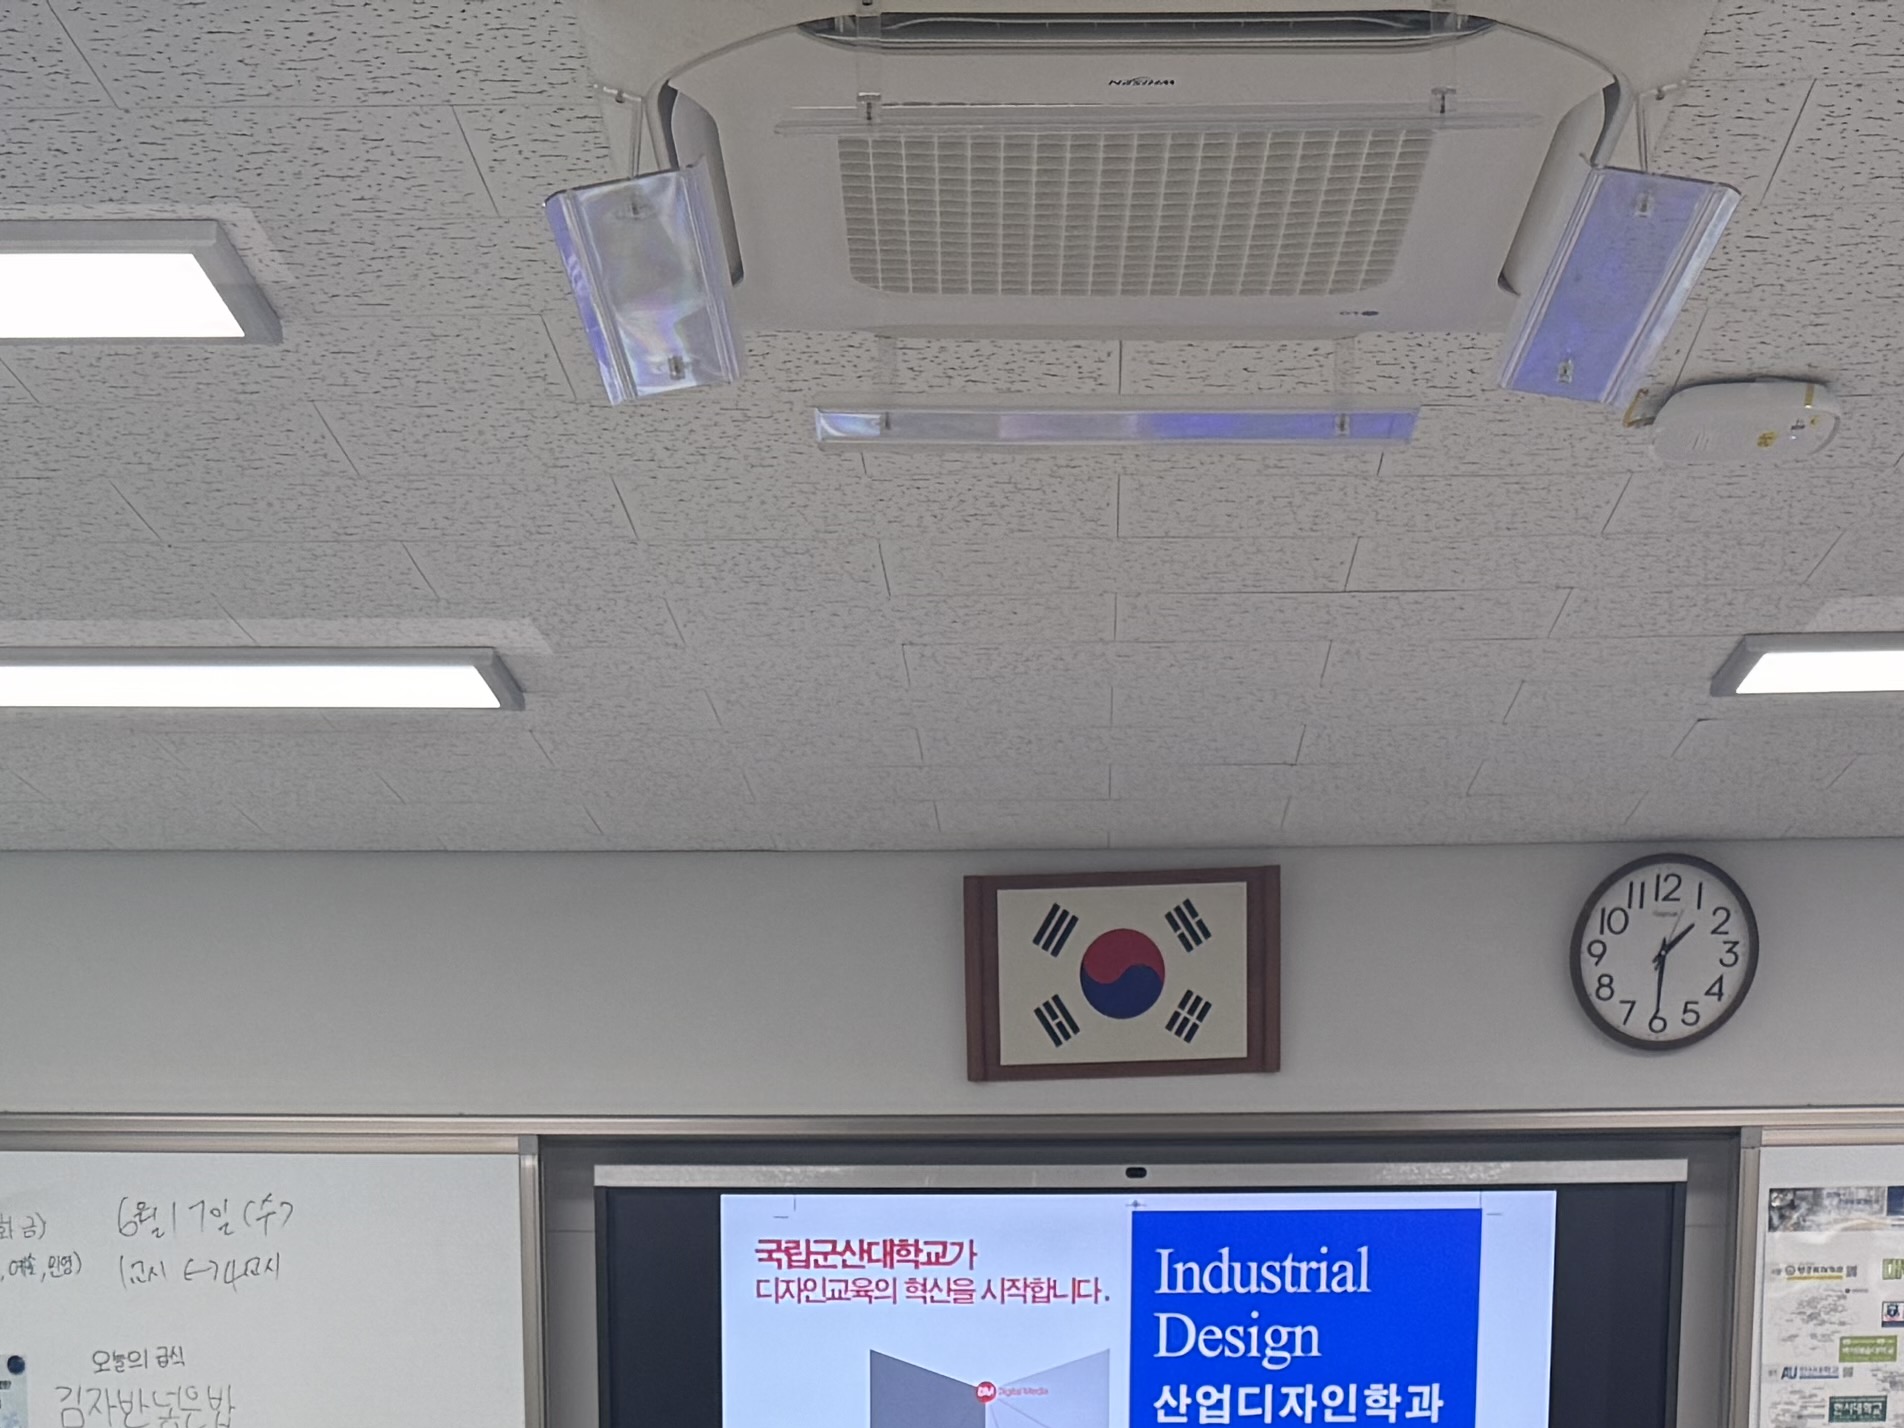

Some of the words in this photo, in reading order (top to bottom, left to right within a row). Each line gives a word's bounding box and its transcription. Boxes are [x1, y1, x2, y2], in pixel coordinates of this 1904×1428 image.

[1628, 881, 1645, 909] 11
[1655, 873, 1682, 902] 12
[1697, 881, 1703, 910] 1
[1600, 907, 1629, 935] 10
[1711, 906, 1731, 935] 2
[1587, 939, 1607, 967] 9
[1719, 941, 1739, 968] 3
[1596, 974, 1614, 1001] 8
[1704, 974, 1724, 1002] 4
[1619, 1001, 1636, 1026] 7
[1649, 1008, 1667, 1033] 6
[1681, 1001, 1700, 1026] 5
[755, 1239, 978, 1270] 국립군산대학교가
[1154, 1246, 1372, 1294] Industrial
[756, 1277, 898, 1304] 디자인교육의
[904, 1277, 976, 1304] 혁신을
[980, 1277, 1110, 1304] 시작합니다.
[1153, 1310, 1322, 1370] Design
[92, 1349, 147, 1373] 오늘의
[156, 1346, 185, 1367] 급식
[1153, 1383, 1444, 1424] 산업디자인학과
